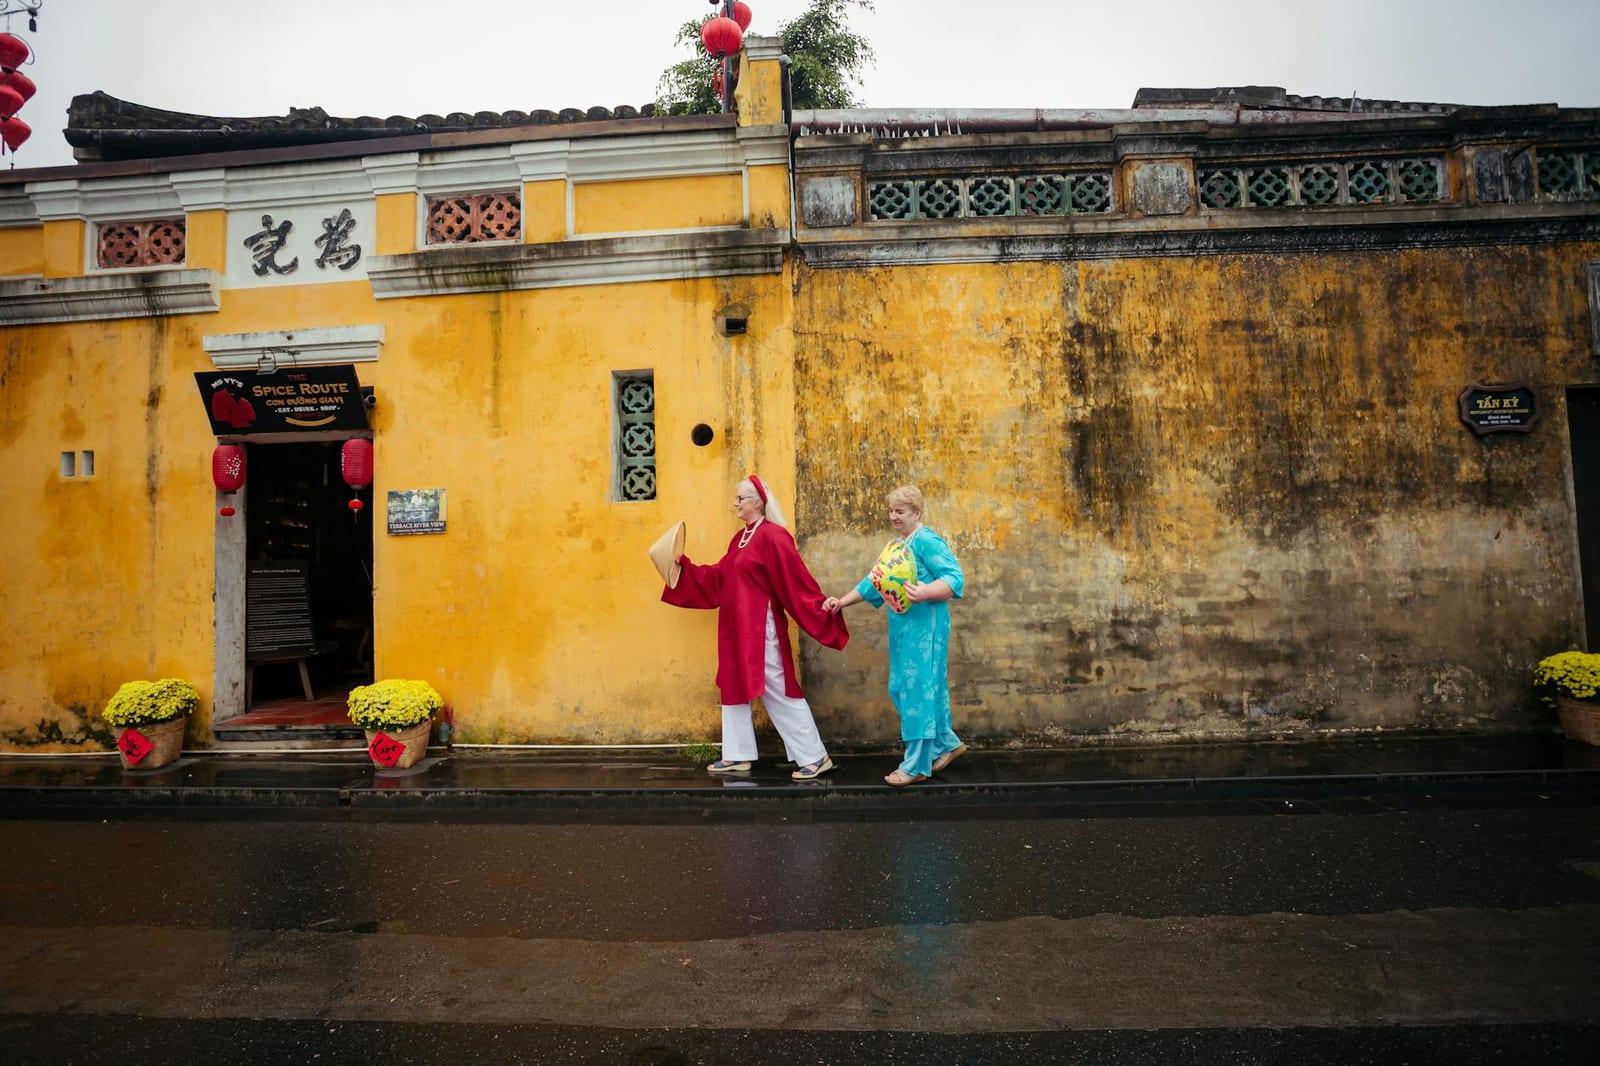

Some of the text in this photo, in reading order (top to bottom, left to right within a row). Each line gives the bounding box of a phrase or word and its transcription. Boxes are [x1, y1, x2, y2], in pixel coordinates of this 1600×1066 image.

[211, 377, 244, 389] MS VY'S
[252, 383, 350, 397] SPICE ROUTE
